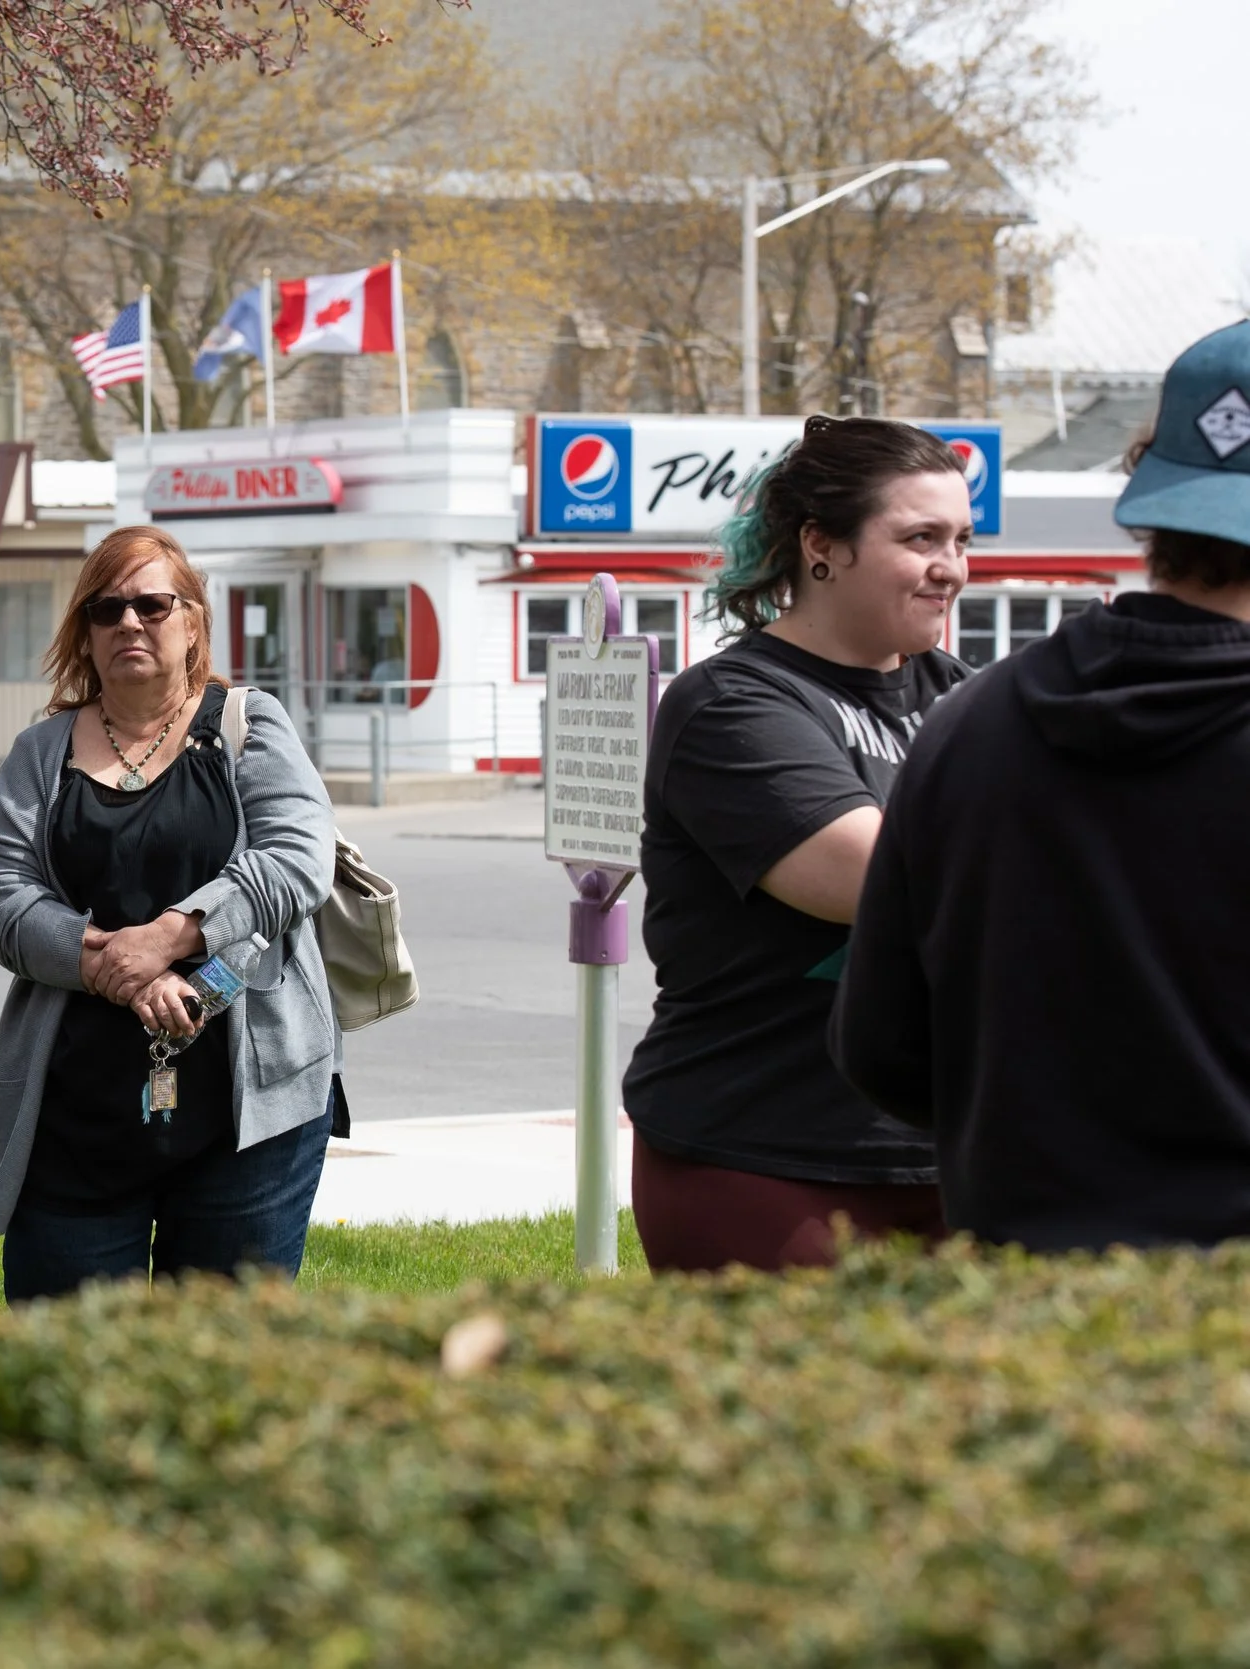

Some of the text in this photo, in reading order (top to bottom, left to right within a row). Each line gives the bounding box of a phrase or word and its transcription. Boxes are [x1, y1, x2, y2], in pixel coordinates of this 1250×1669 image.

[235, 465, 298, 500] DINER
[563, 502, 617, 523] pepsi
[603, 672, 638, 701] FRANK
